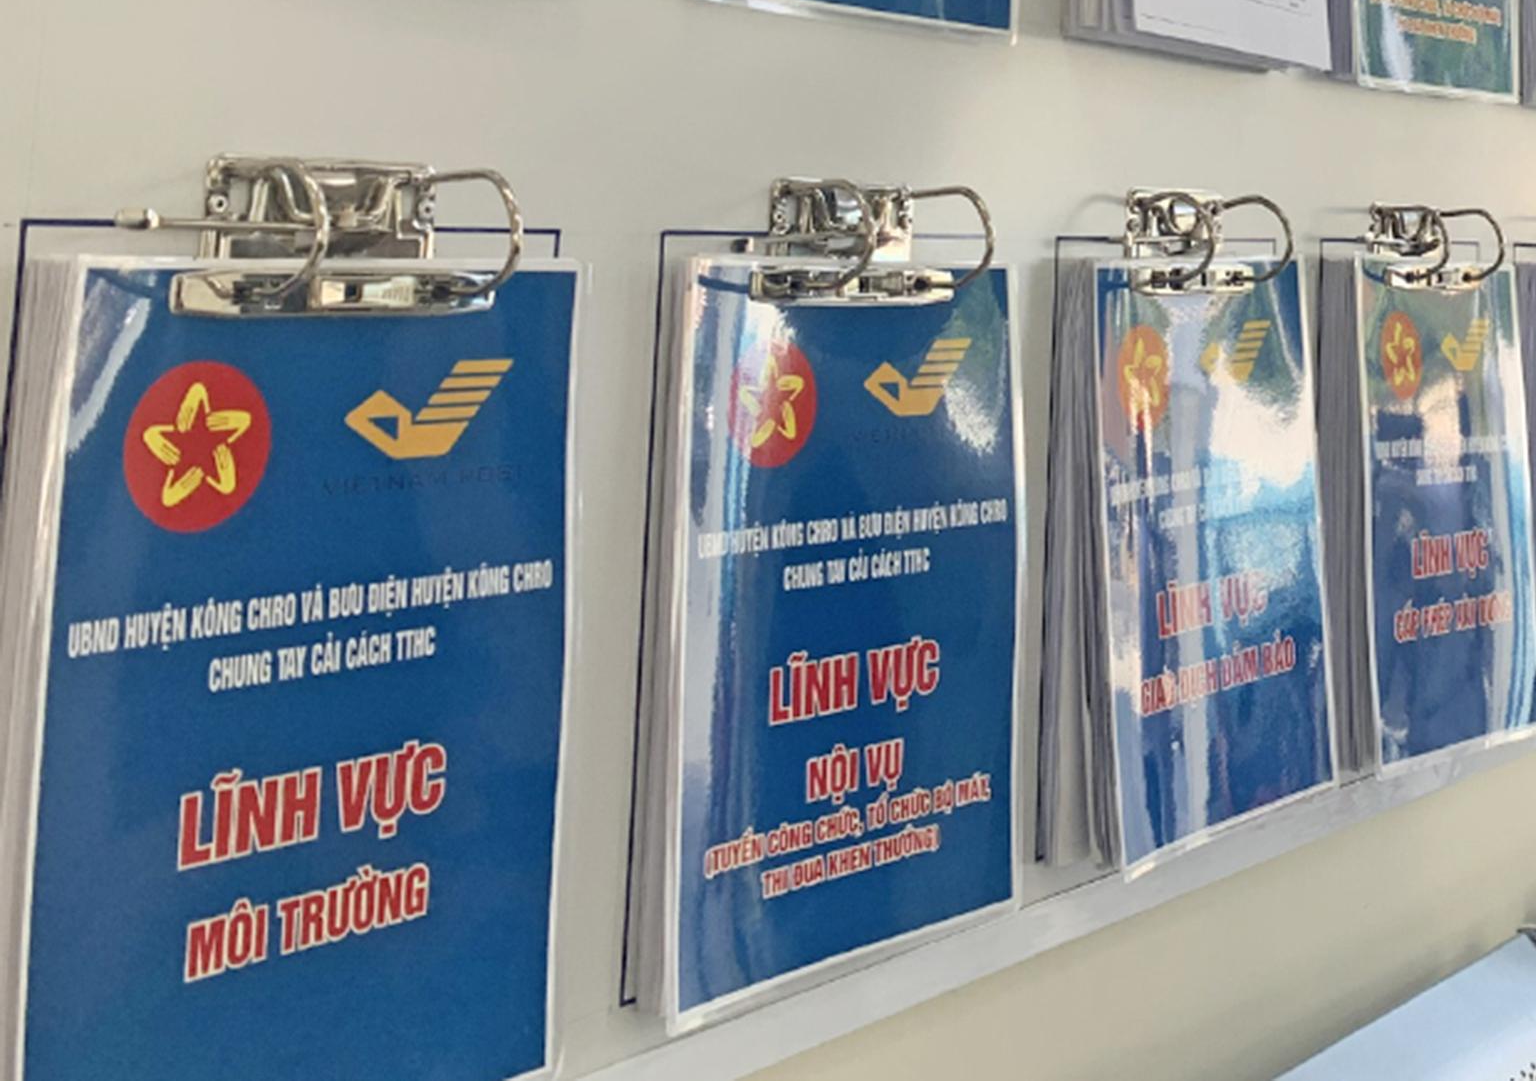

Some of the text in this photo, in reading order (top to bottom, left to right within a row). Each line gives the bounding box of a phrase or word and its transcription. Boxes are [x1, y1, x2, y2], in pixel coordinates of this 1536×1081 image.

[783, 564, 825, 591] CHUNG
[849, 547, 868, 581] CẢI
[870, 550, 901, 580] CÁCH
[903, 547, 930, 572] TTHC
[1411, 526, 1489, 579] LĨNH VỰC
[67, 559, 553, 660] UBND HUYỆN KÔNG CHRO VÀ BƯU ĐIỆN HUYỆN KÔNG CHRO
[1156, 578, 1213, 640] LĨNH
[208, 626, 437, 693] CHUNG TAY CẢI CÁCH TTHC
[769, 635, 940, 726] LĨNH VỰC
[1220, 640, 1259, 690] ĐẢM
[1261, 628, 1296, 679] BẢO
[806, 737, 904, 804] NỘI VỤ
[177, 739, 447, 871] LĨNH VỰC
[767, 821, 813, 857] CÔNG
[890, 785, 932, 821] CHỨC
[933, 779, 954, 814] BỘ
[761, 870, 790, 899] THI
[791, 855, 824, 887] ĐUA
[826, 844, 872, 877] KHEN
[183, 862, 429, 984] MÔI TRƯỜNG
